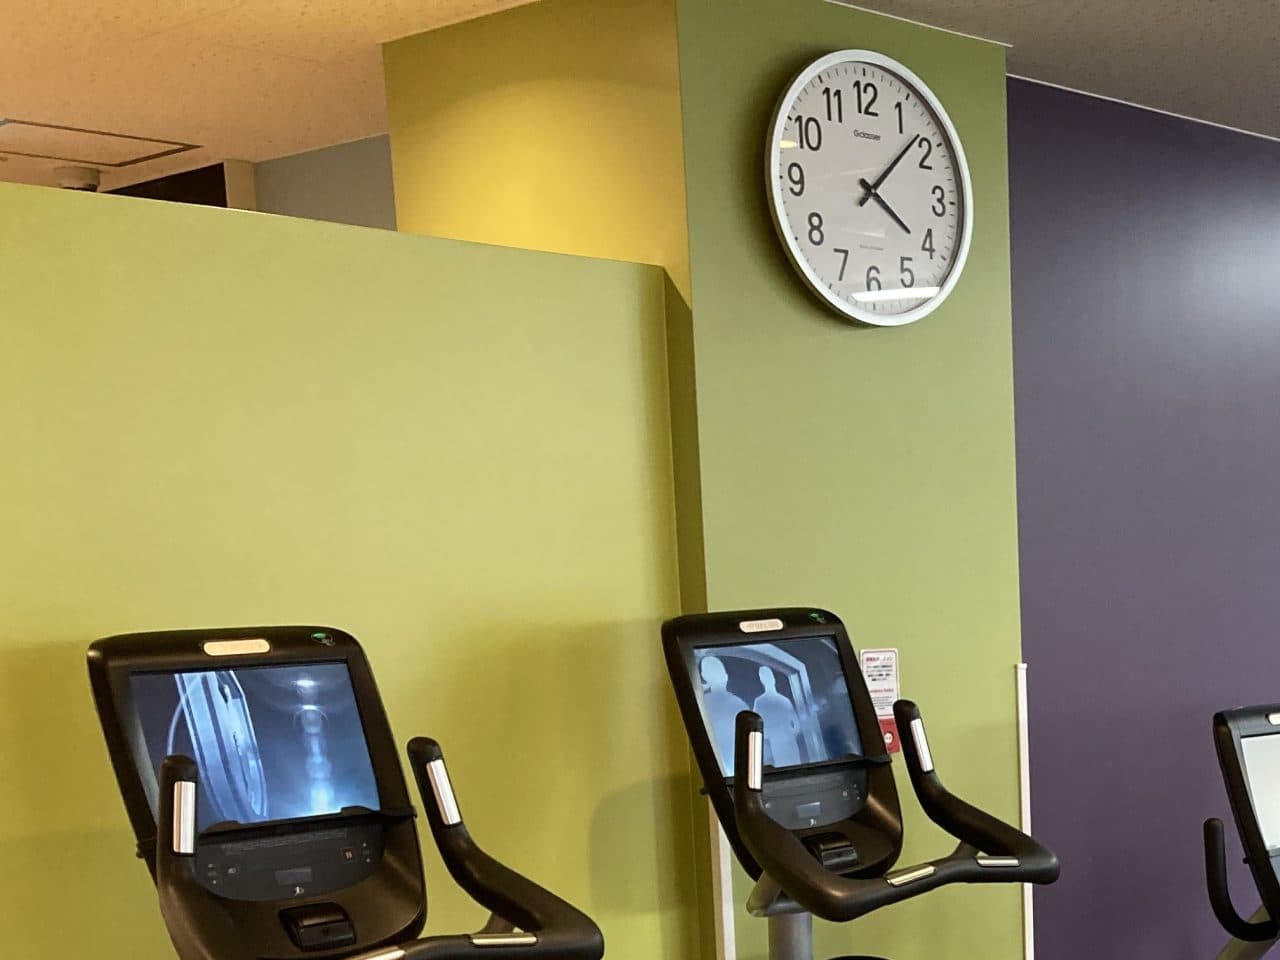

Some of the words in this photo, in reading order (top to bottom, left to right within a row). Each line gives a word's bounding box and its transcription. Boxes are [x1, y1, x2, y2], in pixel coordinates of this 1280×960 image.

[822, 87, 843, 123] 11
[853, 80, 879, 117] 12
[794, 115, 822, 151] 10
[894, 101, 904, 134] 1
[918, 137, 932, 170] 2
[788, 162, 805, 196] 9
[931, 185, 946, 217] 3
[808, 212, 824, 246] 8
[921, 228, 936, 260] 4
[833, 248, 849, 281] 7
[866, 265, 882, 293] 6
[900, 256, 915, 288] 5
